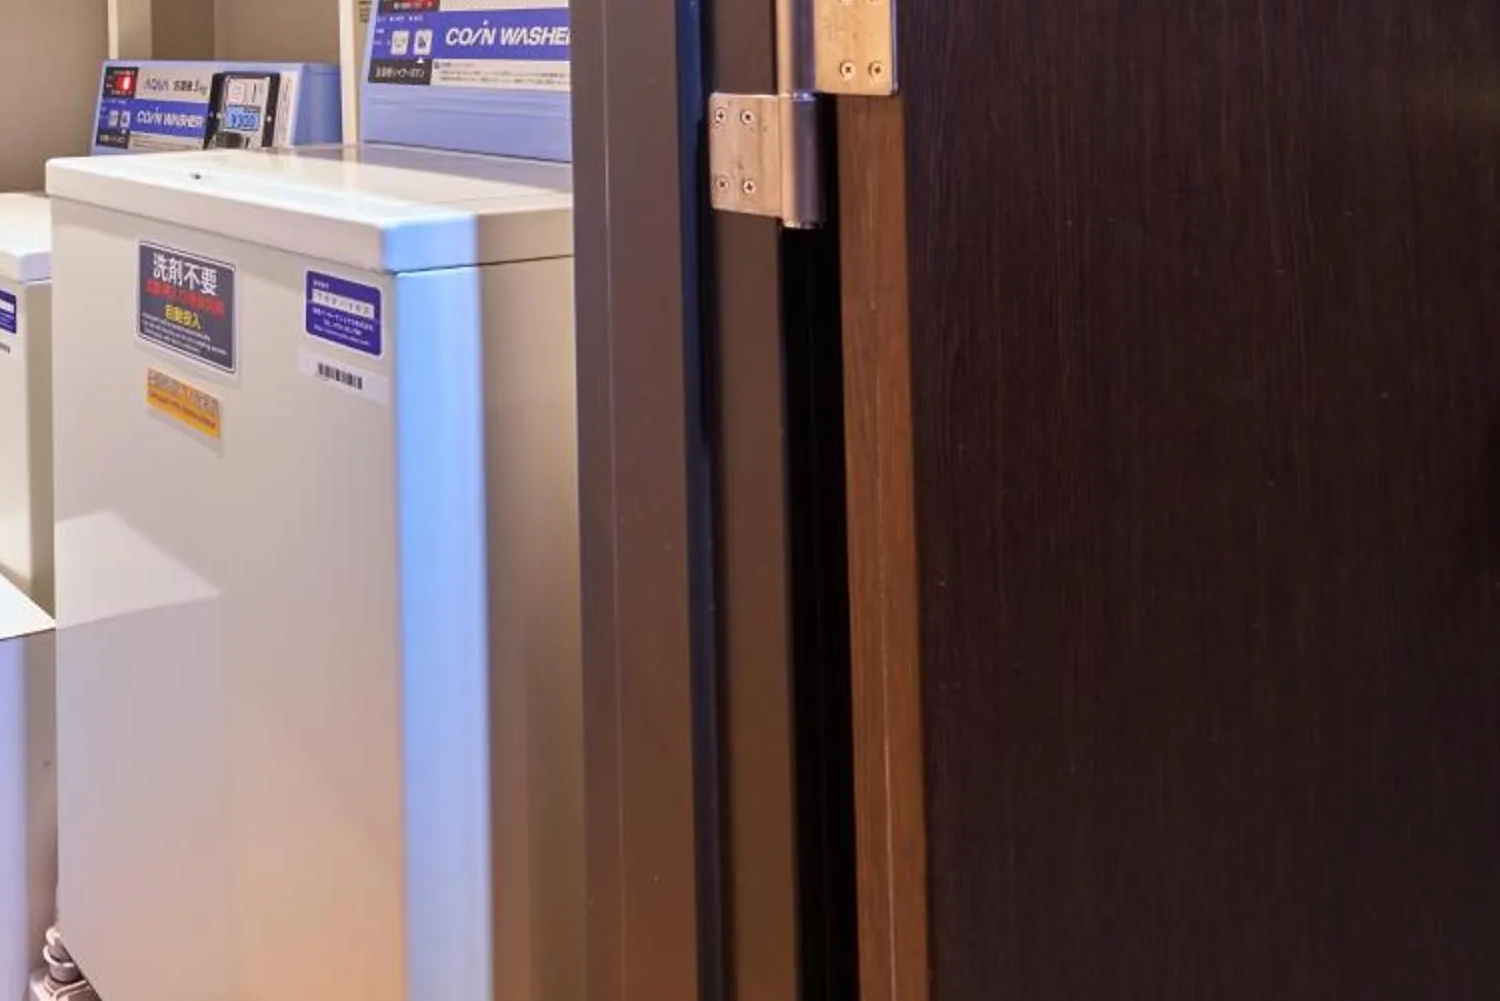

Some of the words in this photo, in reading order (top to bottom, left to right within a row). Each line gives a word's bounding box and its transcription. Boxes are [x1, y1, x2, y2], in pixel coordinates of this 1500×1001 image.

[445, 19, 496, 46] COIN
[153, 252, 217, 296] 洗剤不要
